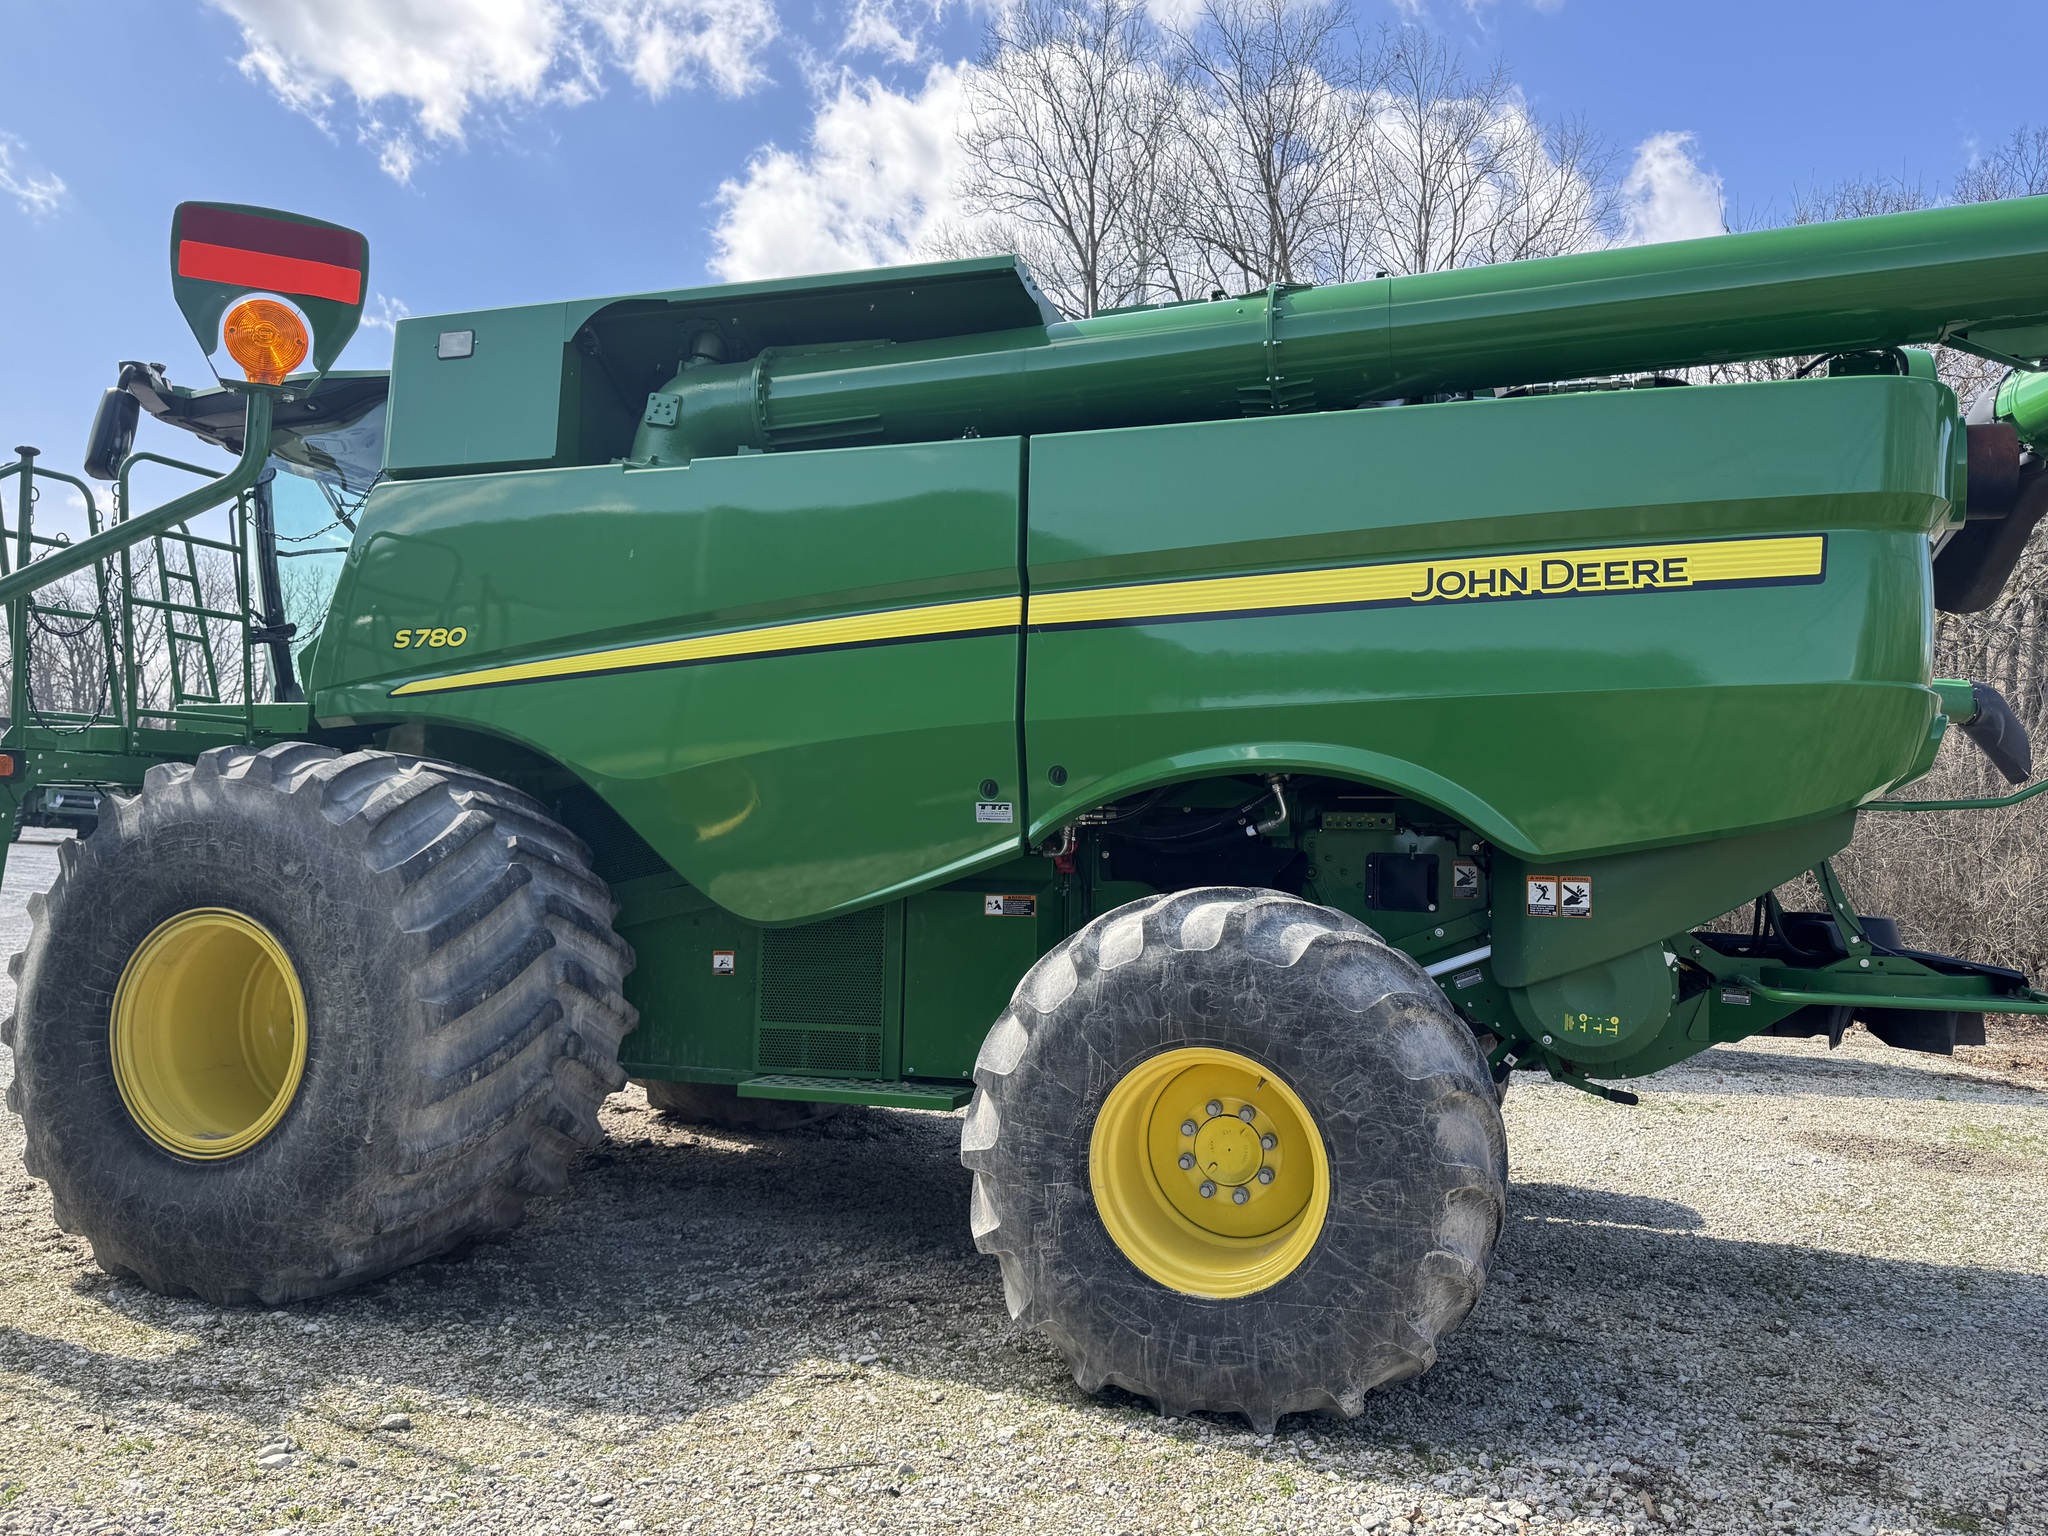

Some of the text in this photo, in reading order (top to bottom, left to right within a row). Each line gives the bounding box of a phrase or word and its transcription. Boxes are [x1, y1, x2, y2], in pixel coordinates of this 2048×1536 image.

[1411, 557, 1689, 598] JOHN DEERE
[392, 626, 468, 649] S780
[978, 803, 1010, 811] TTG
